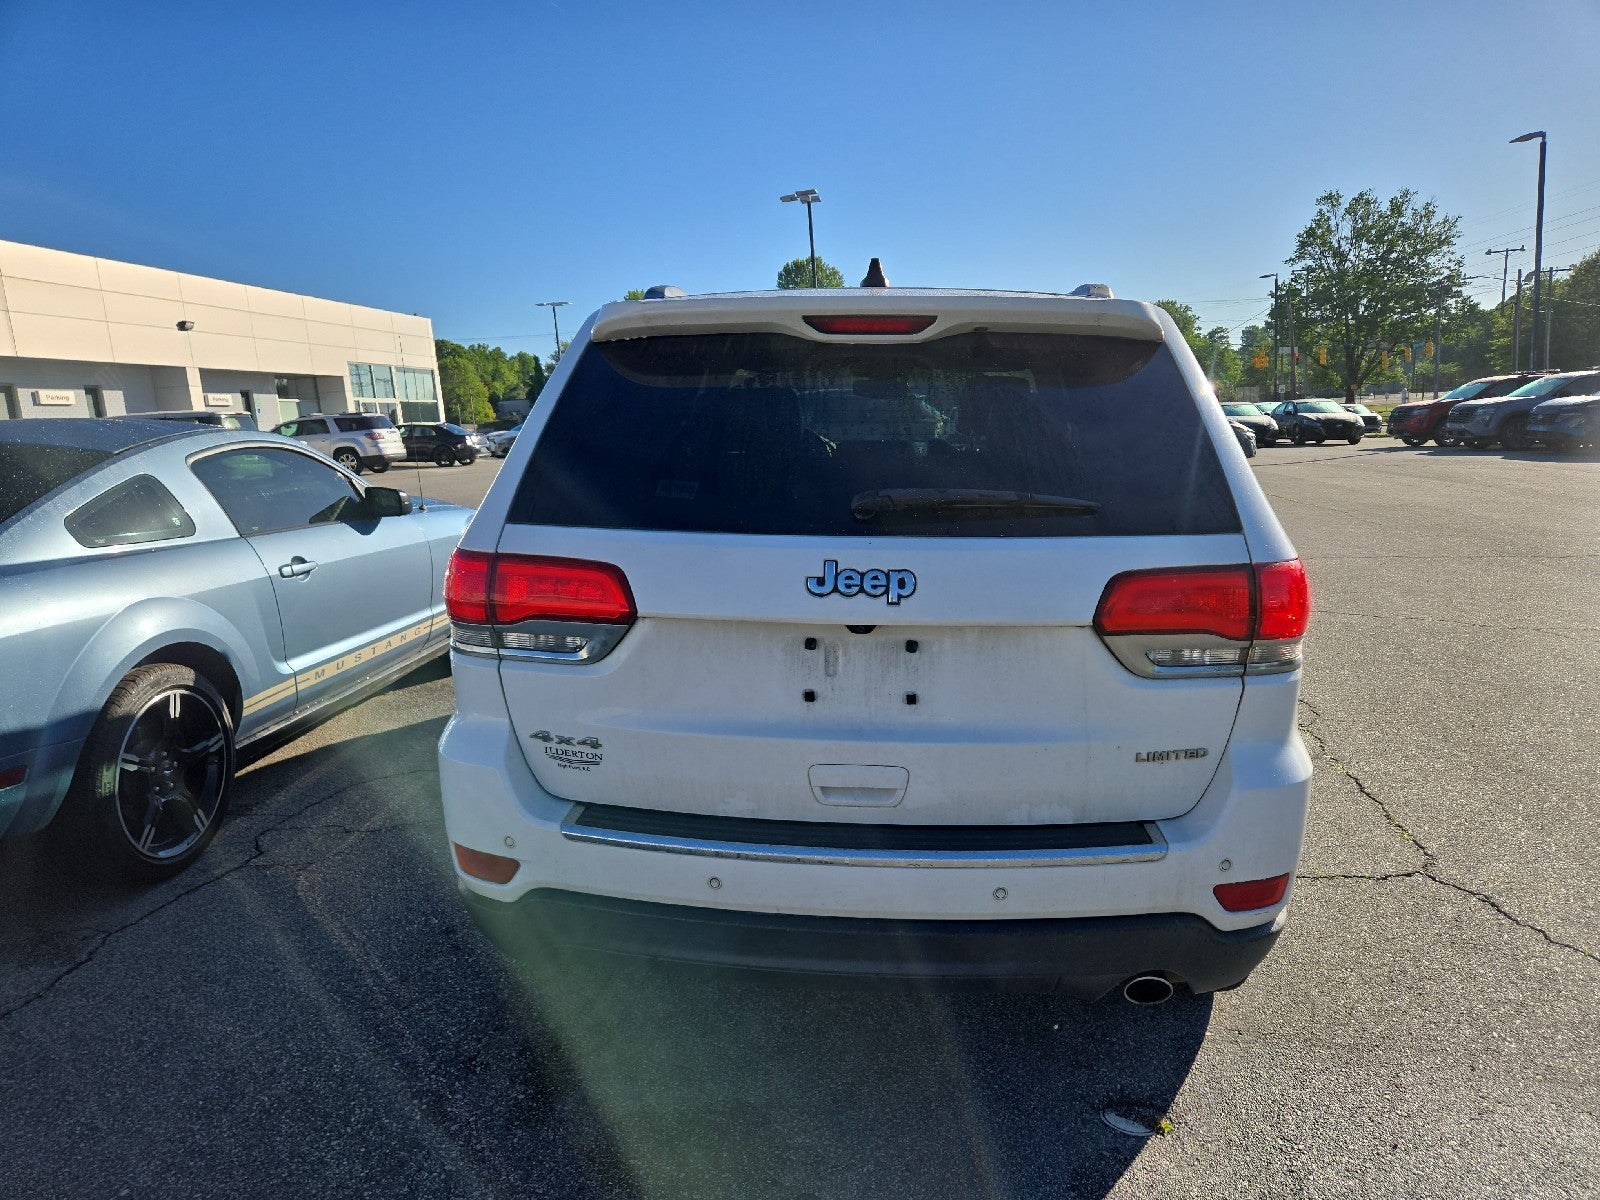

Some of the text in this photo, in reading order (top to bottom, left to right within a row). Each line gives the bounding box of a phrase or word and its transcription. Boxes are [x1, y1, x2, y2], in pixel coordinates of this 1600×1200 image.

[806, 559, 917, 605] Jeep
[314, 629, 422, 681] MUSTANG
[544, 746, 604, 761] ILDERTON
[1135, 747, 1209, 763] LIMITED
